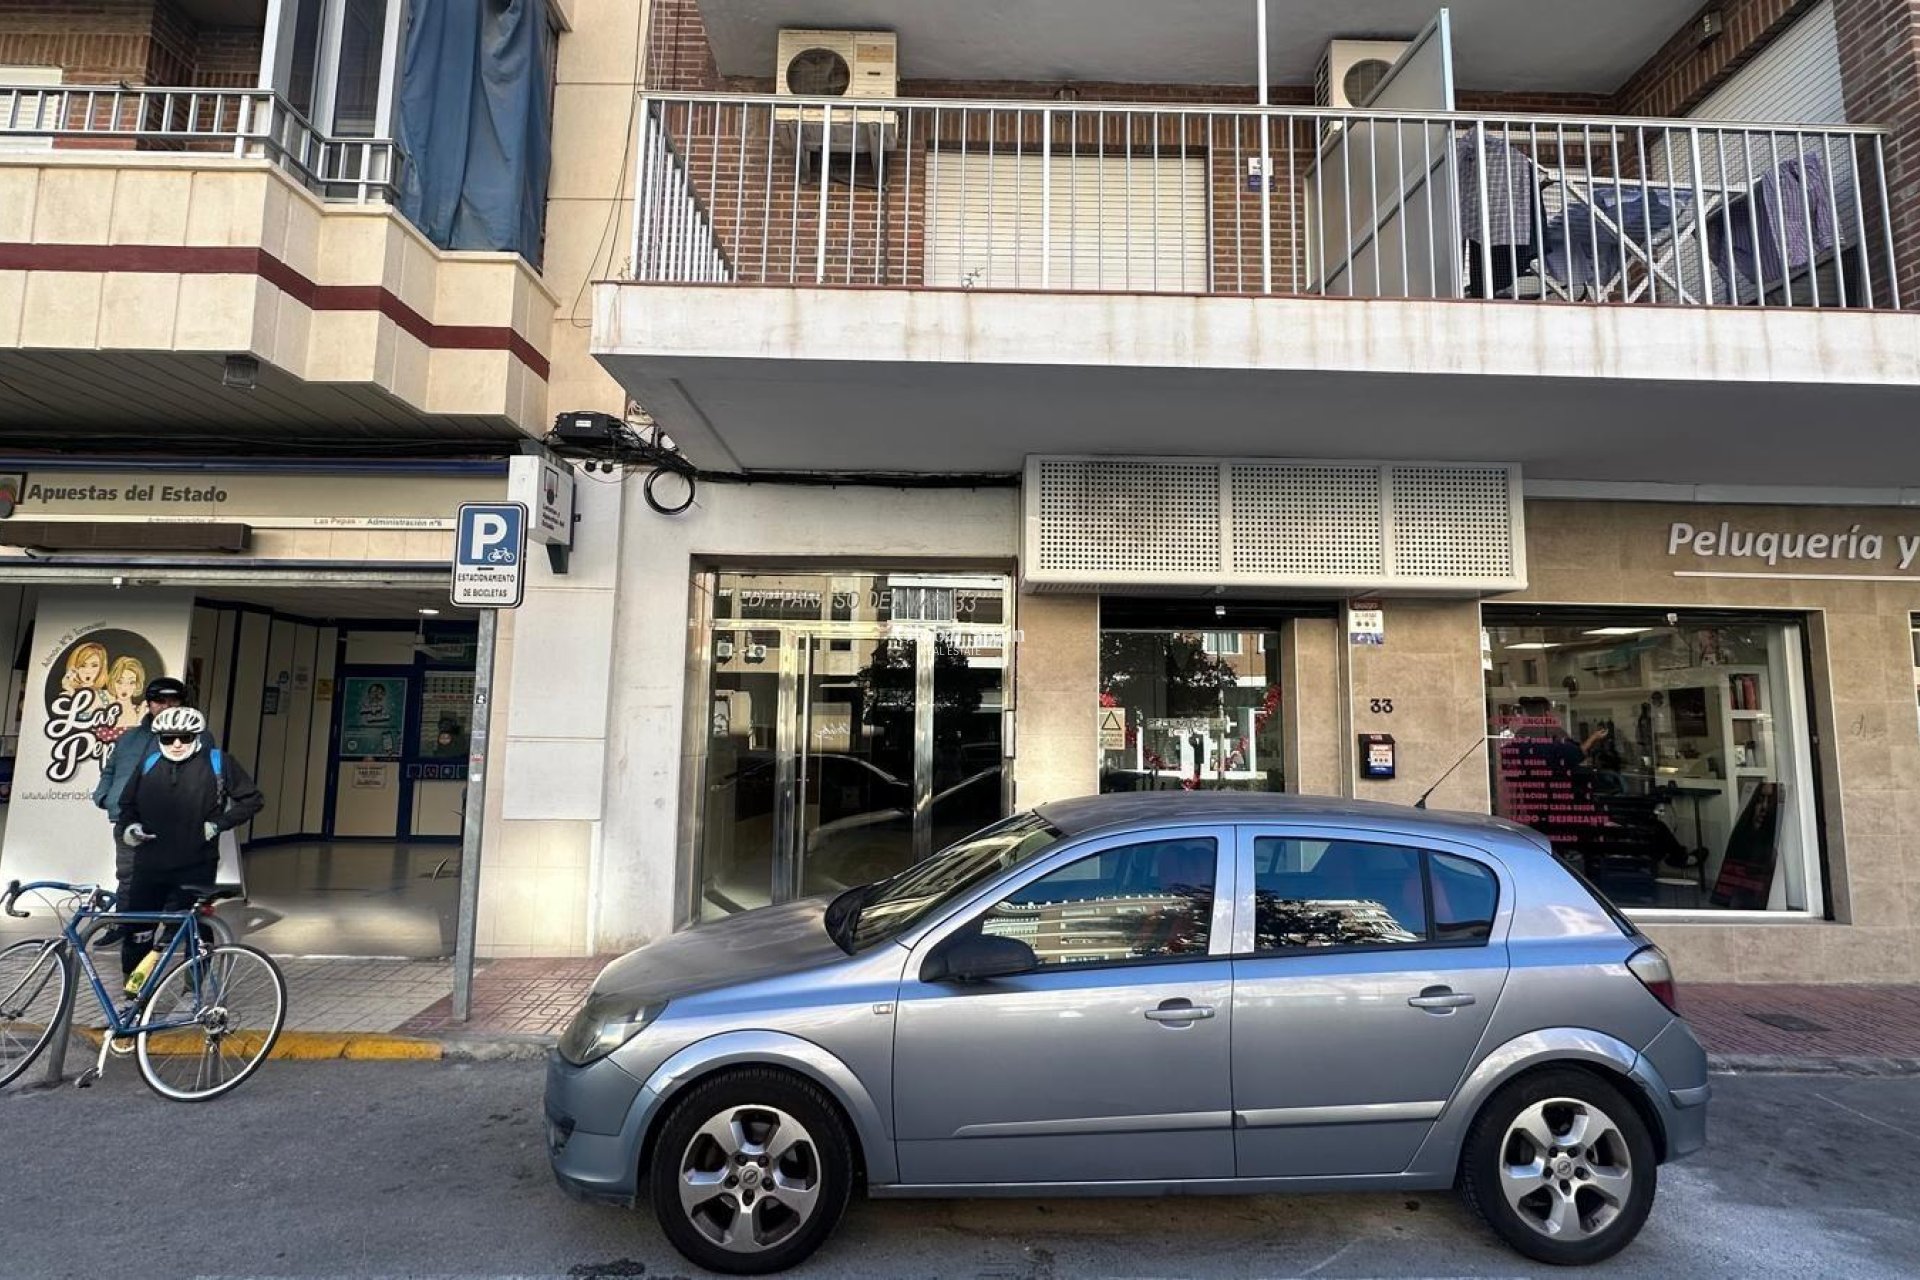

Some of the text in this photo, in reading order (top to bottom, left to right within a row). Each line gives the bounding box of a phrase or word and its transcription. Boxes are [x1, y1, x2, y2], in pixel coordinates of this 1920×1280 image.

[28, 484, 228, 504] Apuestas del Estado
[367, 517, 427, 527] Administración
[471, 512, 508, 560] P
[1668, 521, 1920, 570] Peluquería y
[458, 573, 515, 583] ESTACIONAMIENTO
[463, 588, 507, 598] DE BICICLETAS
[45, 689, 122, 738] Las
[1370, 698, 1393, 714] 33
[47, 731, 115, 782] Pep
